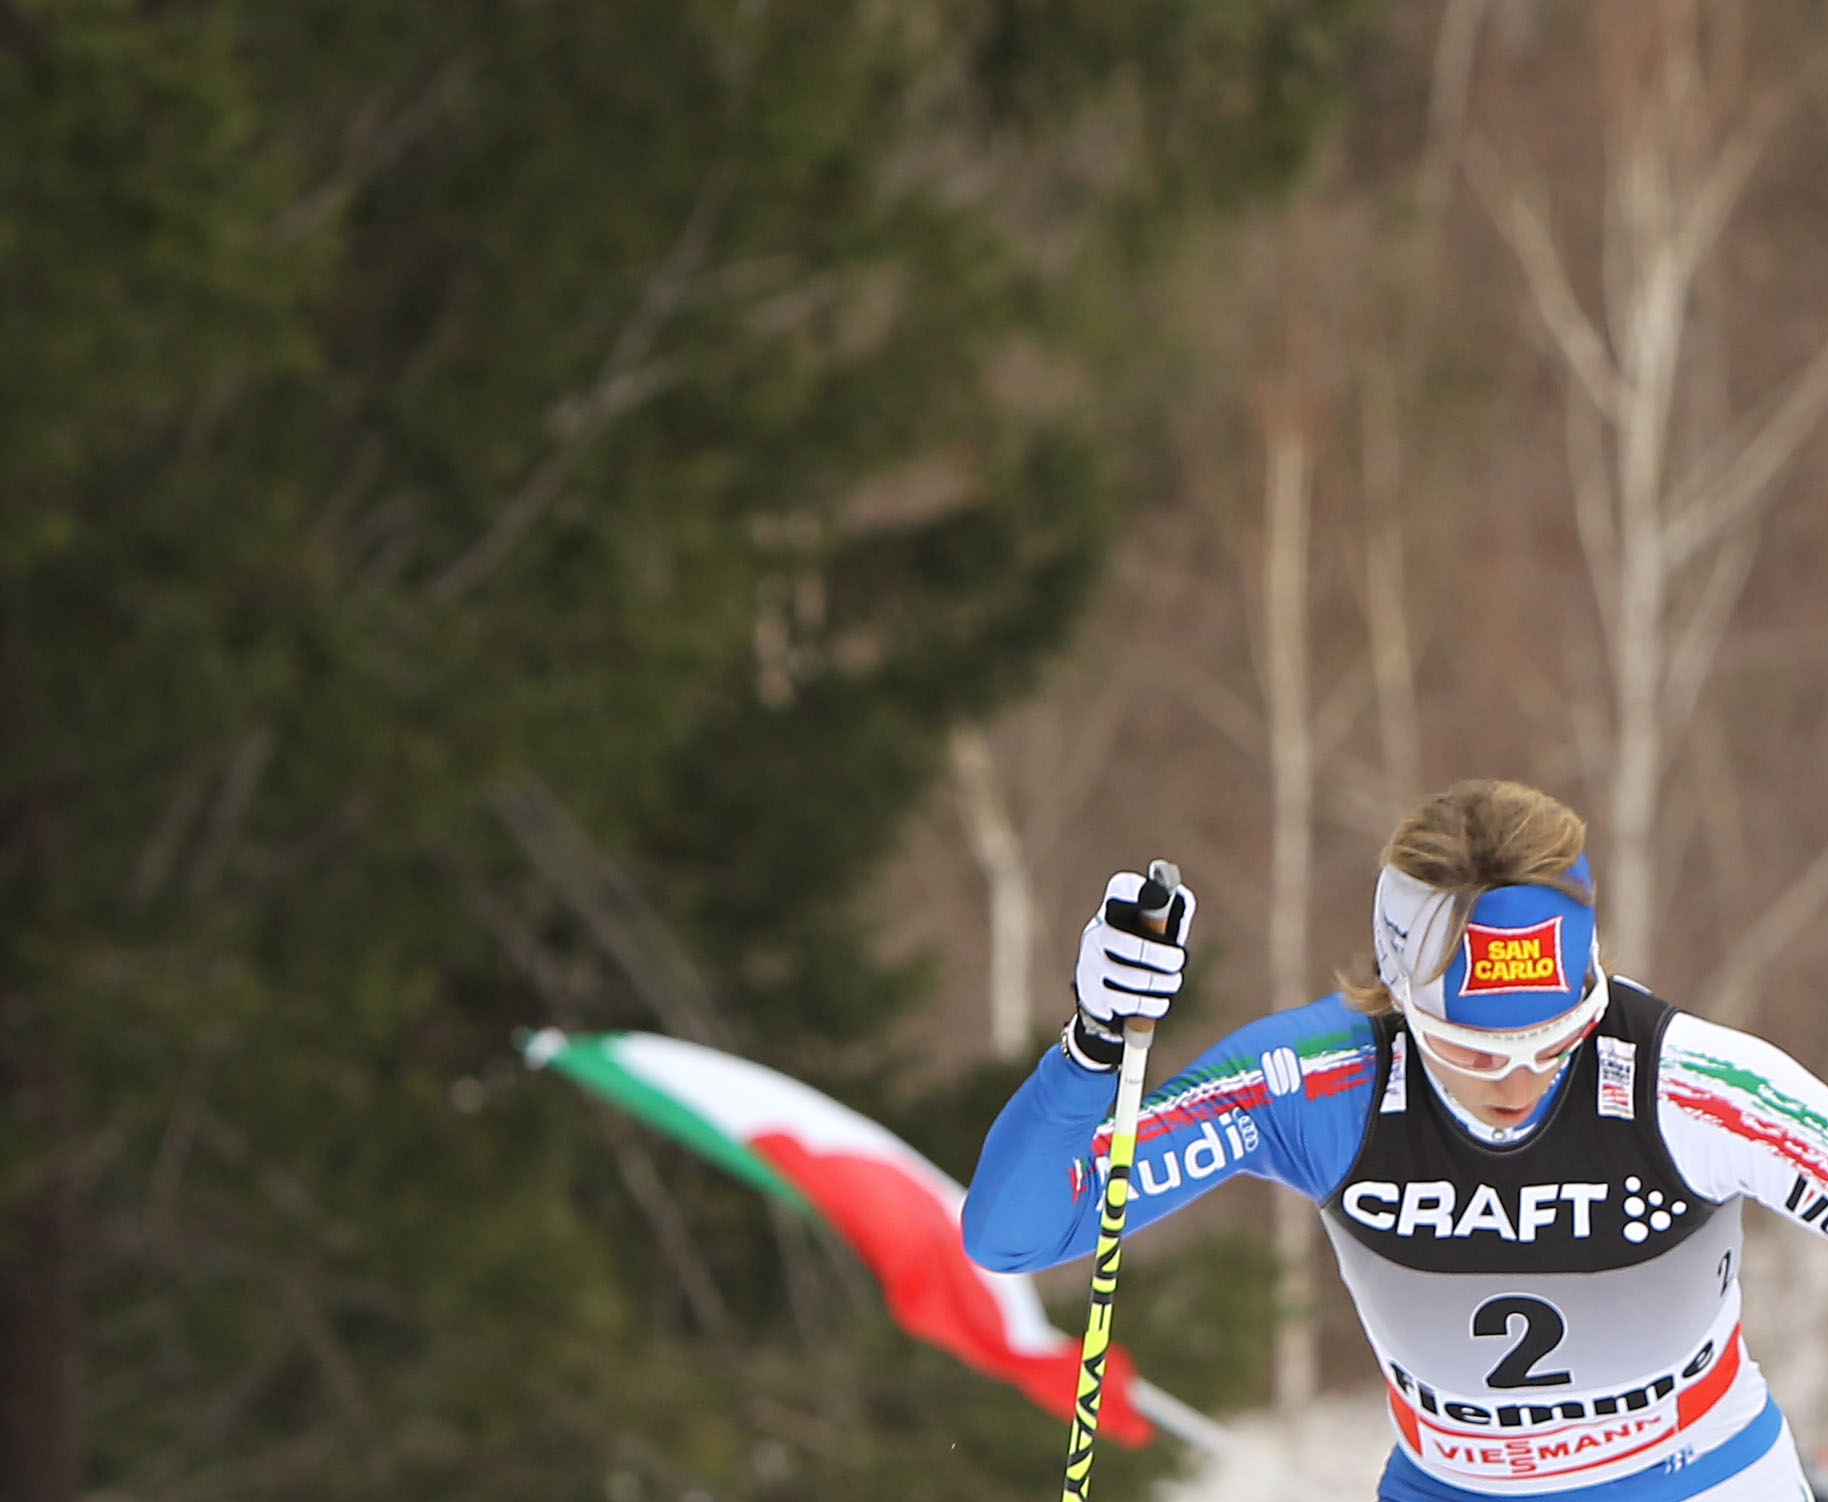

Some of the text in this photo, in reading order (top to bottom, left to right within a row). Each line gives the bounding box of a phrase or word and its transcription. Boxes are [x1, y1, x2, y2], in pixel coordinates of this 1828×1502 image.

[1474, 957, 1554, 981] CARLO
[1488, 939, 1540, 959] SAN
[1342, 1180, 1608, 1242] CRAFT
[1473, 1297, 1572, 1389] 2
